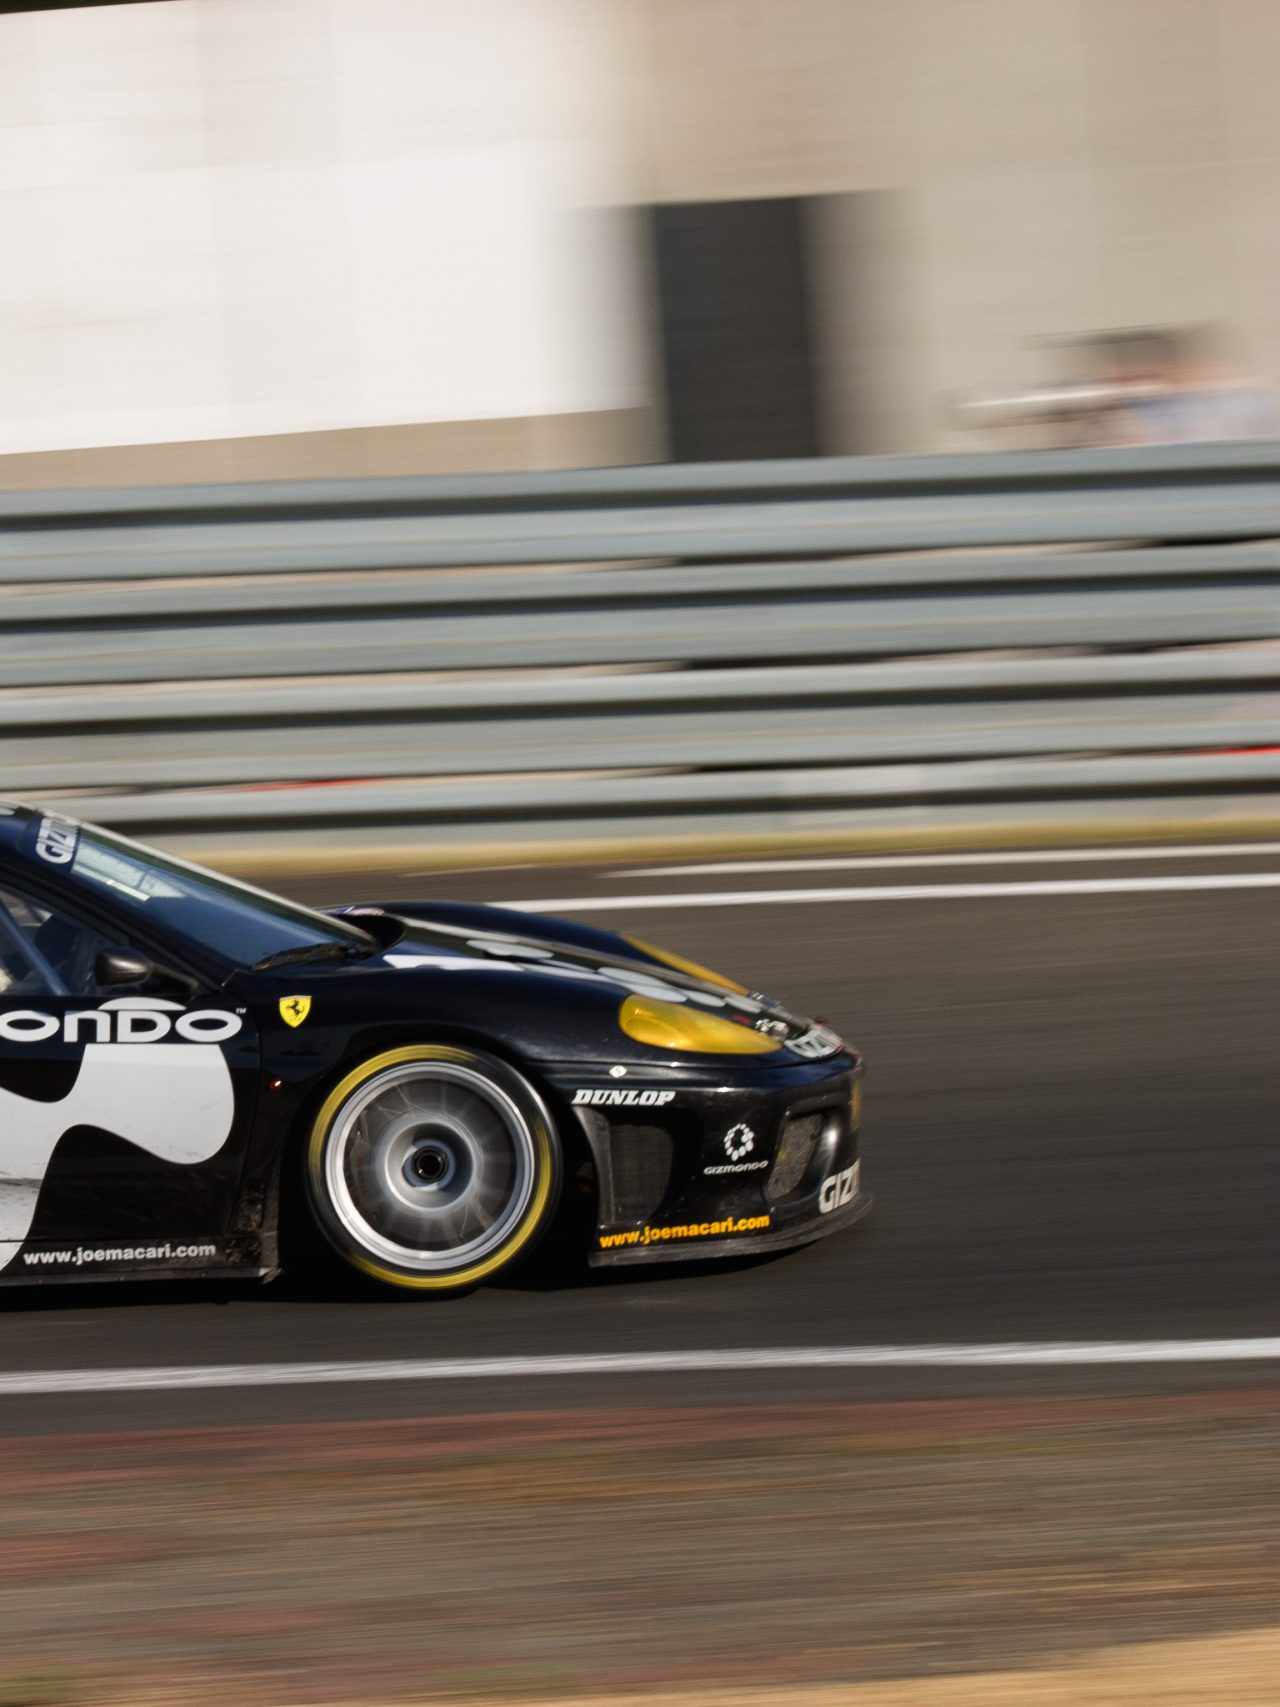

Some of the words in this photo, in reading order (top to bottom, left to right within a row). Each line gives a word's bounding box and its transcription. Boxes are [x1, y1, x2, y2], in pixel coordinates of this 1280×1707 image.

[571, 1088, 676, 1106] DUNLOP
[703, 1160, 769, 1176] GIZMONDO
[599, 1215, 770, 1249] www.joemacari.com
[23, 1242, 217, 1266] www.joemacari.com
